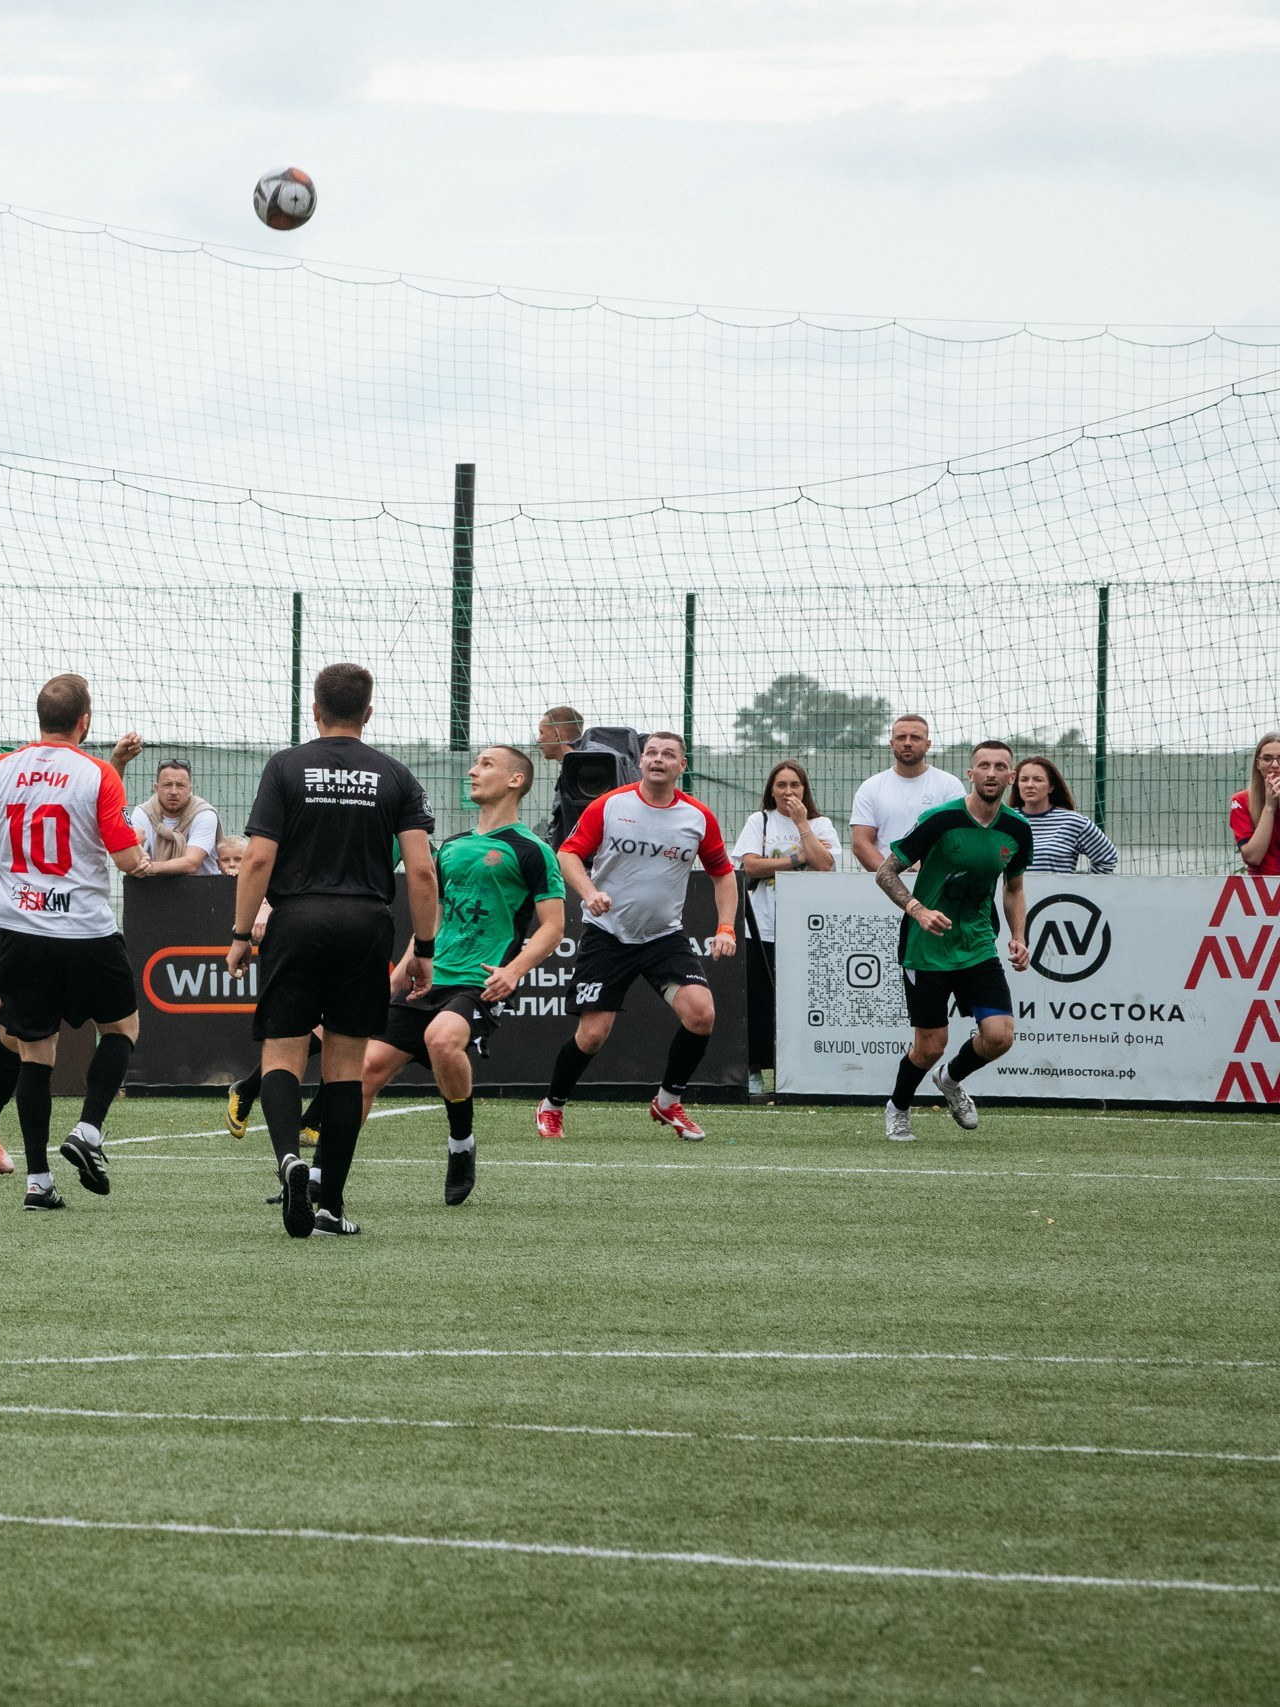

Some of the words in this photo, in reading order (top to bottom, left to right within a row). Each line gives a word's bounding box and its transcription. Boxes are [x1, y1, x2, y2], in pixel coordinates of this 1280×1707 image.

[16, 772, 69, 789] АРЧИ
[304, 768, 378, 787] ЭНКА
[305, 784, 377, 796] ТЕХНИКА
[339, 798, 376, 807] ЦИФРОВАЯ
[6, 803, 73, 877] 10
[166, 963, 258, 997] Winl
[575, 982, 603, 1005] 80
[1124, 1031, 1164, 1047] фонд
[997, 1066, 1137, 1080] www.людивостока.рф
